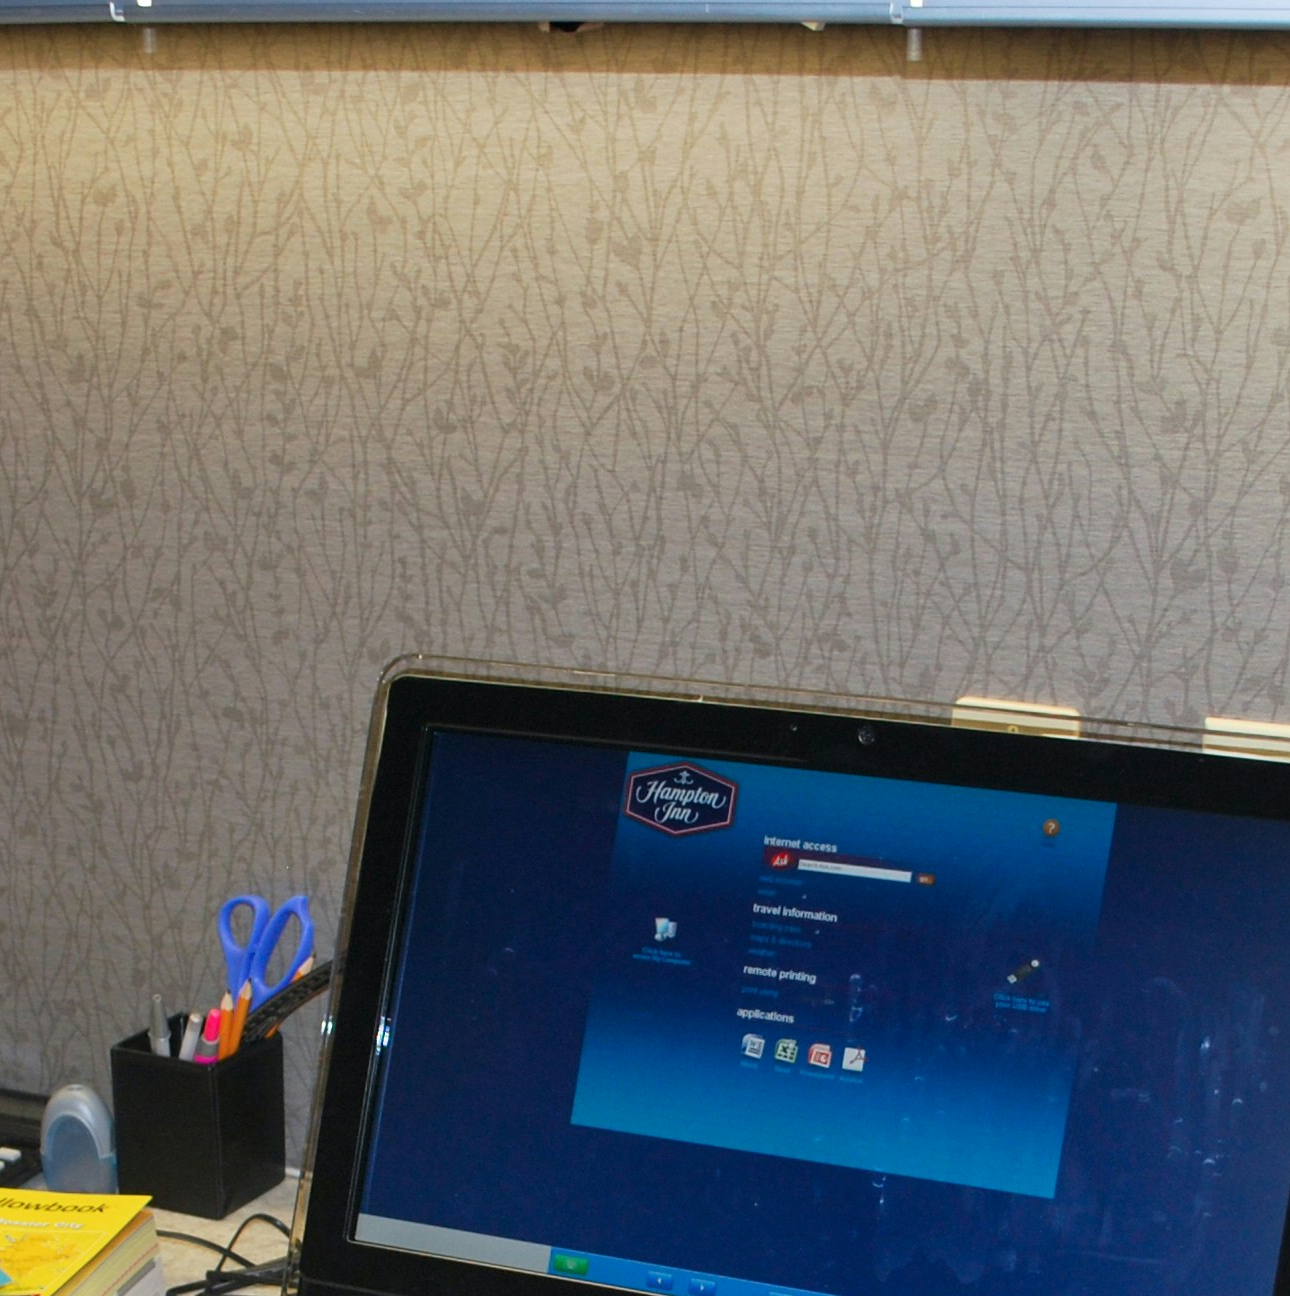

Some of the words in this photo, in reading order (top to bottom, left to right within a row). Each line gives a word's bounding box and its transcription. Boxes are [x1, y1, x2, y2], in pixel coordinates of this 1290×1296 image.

[636, 780, 727, 809] Hampton
[654, 801, 699, 824] Inn
[803, 840, 837, 853] access
[772, 855, 788, 867] Ask
[753, 903, 781, 916] travel
[743, 966, 777, 978] remote
[779, 970, 817, 985] printing
[737, 1008, 795, 1024] applications
